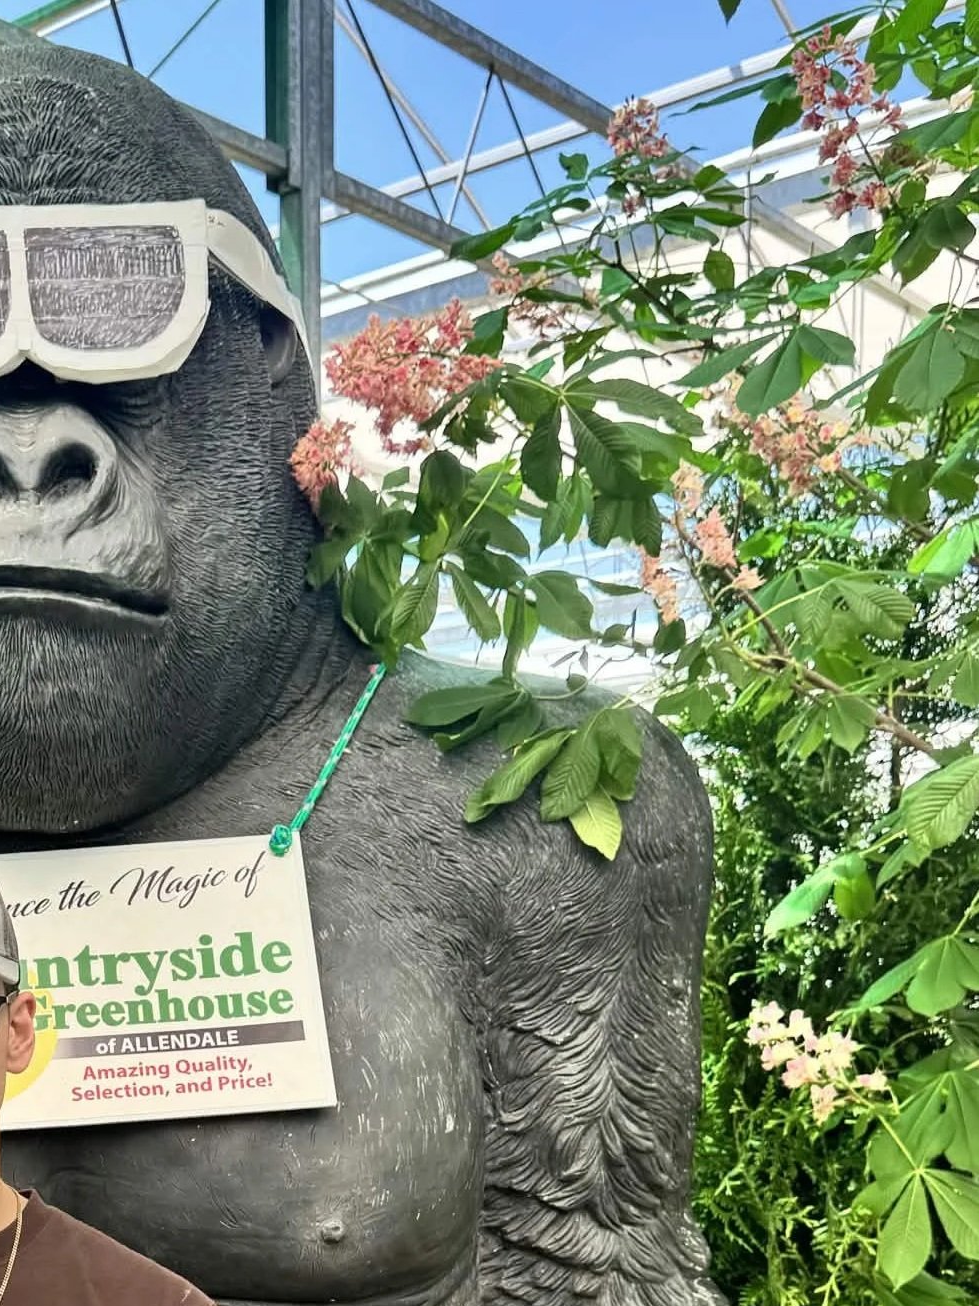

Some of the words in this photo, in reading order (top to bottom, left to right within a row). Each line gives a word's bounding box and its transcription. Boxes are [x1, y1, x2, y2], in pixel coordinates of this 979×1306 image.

[58, 880, 101, 911] the
[110, 866, 228, 908] Magic
[234, 851, 266, 898] of
[96, 1039, 117, 1055] of
[121, 1029, 240, 1053] ALLENDALE
[83, 1062, 170, 1082] Amazing
[175, 1055, 253, 1076] Quality,
[72, 1082, 170, 1102] Selection,
[175, 1076, 213, 1095] and
[218, 1073, 273, 1091] Price!
